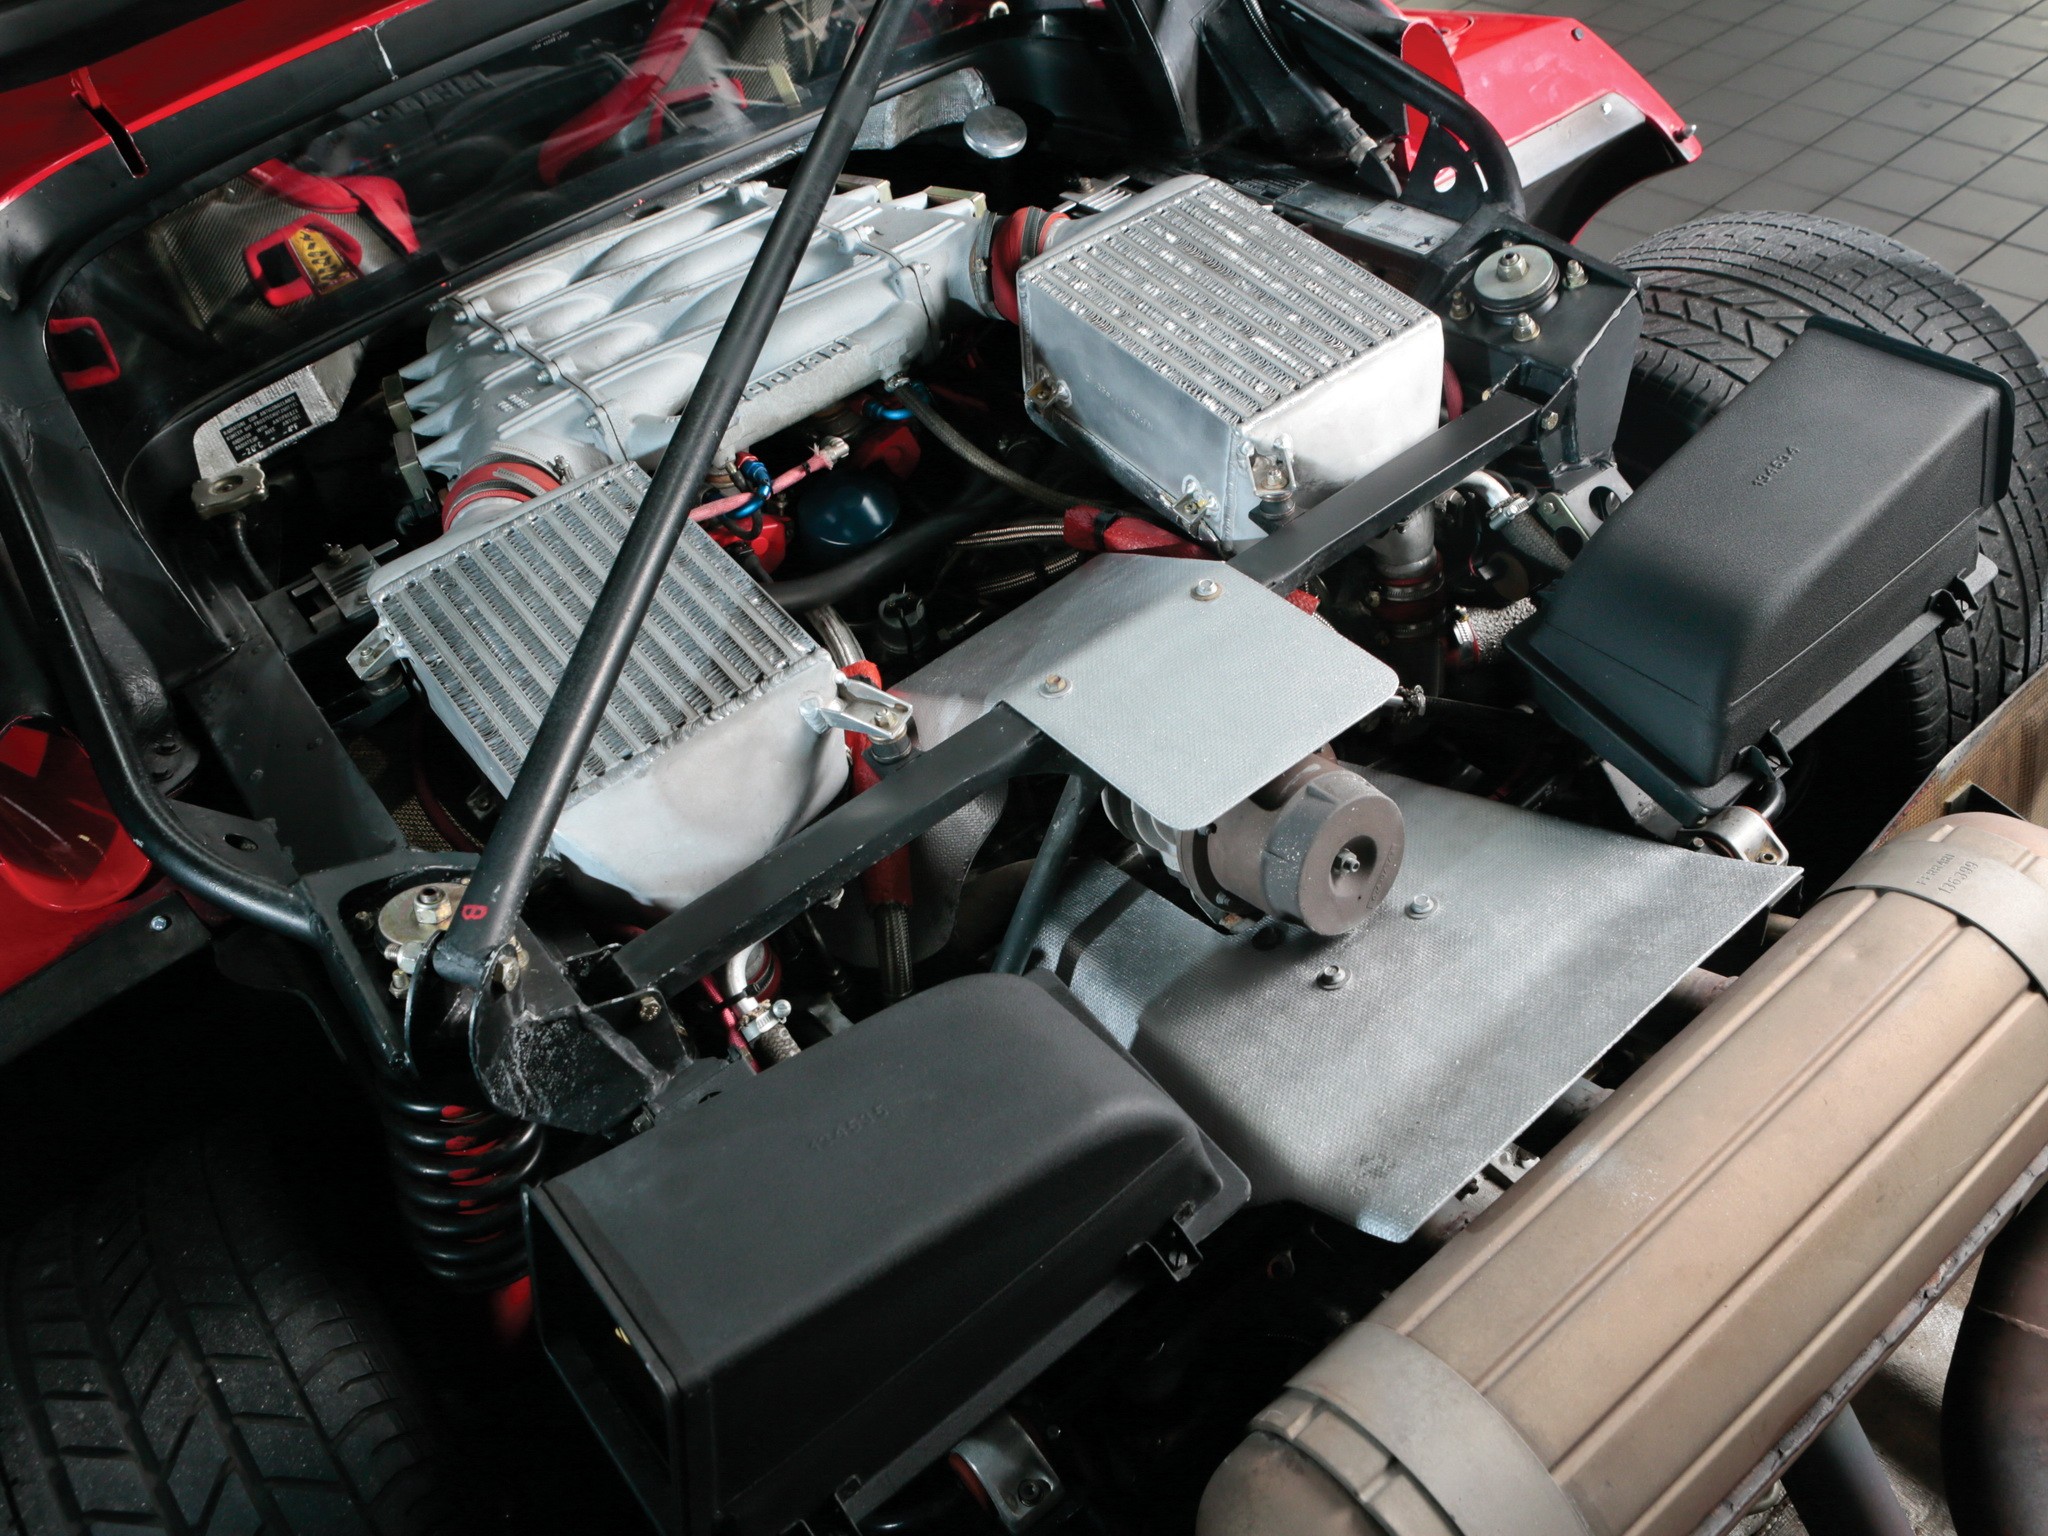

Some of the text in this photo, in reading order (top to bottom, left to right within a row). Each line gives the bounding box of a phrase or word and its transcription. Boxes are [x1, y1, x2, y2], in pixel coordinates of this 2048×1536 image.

[222, 421, 246, 436] RADIATORE
[247, 414, 258, 422] CON
[231, 409, 299, 446] RADIATOR WITH ANTIFREEZE
[1917, 853, 1956, 886] FERRARI
[1937, 860, 1980, 894] 136399
